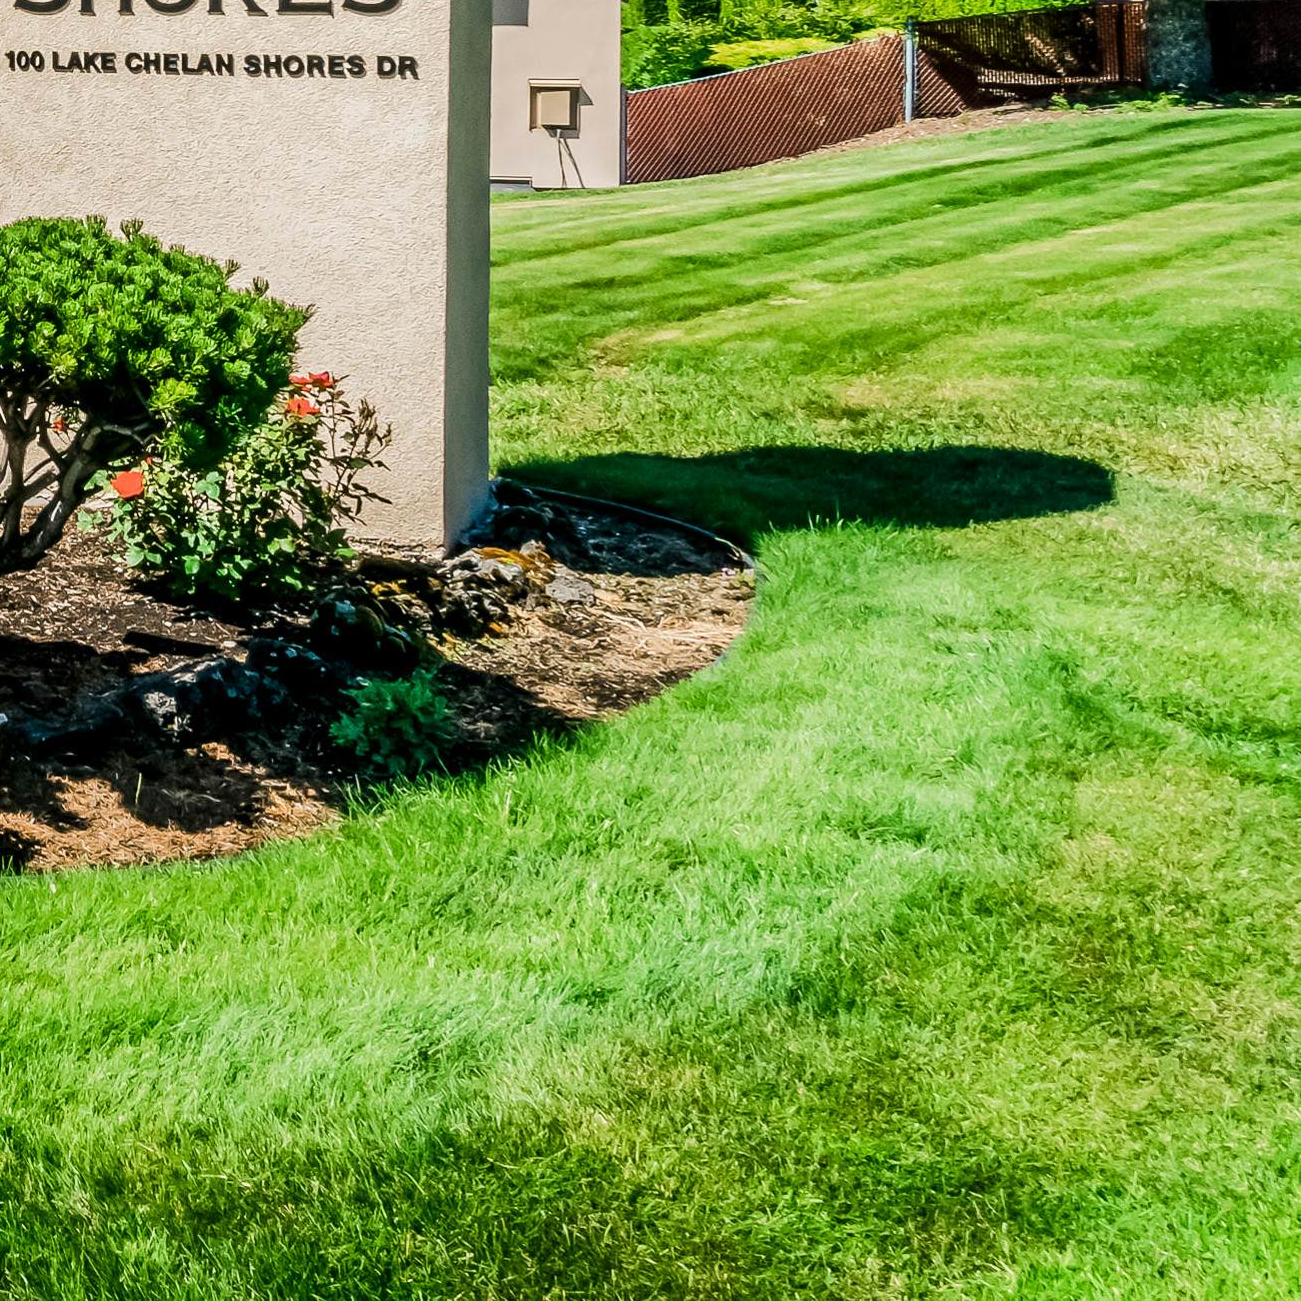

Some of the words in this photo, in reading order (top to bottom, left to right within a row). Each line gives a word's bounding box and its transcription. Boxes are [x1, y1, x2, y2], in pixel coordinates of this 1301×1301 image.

[4, 50, 45, 73] 100
[52, 51, 117, 74] LAKE
[124, 52, 235, 77] CHELAN
[243, 54, 367, 78] SHORES
[376, 55, 420, 80] DR
